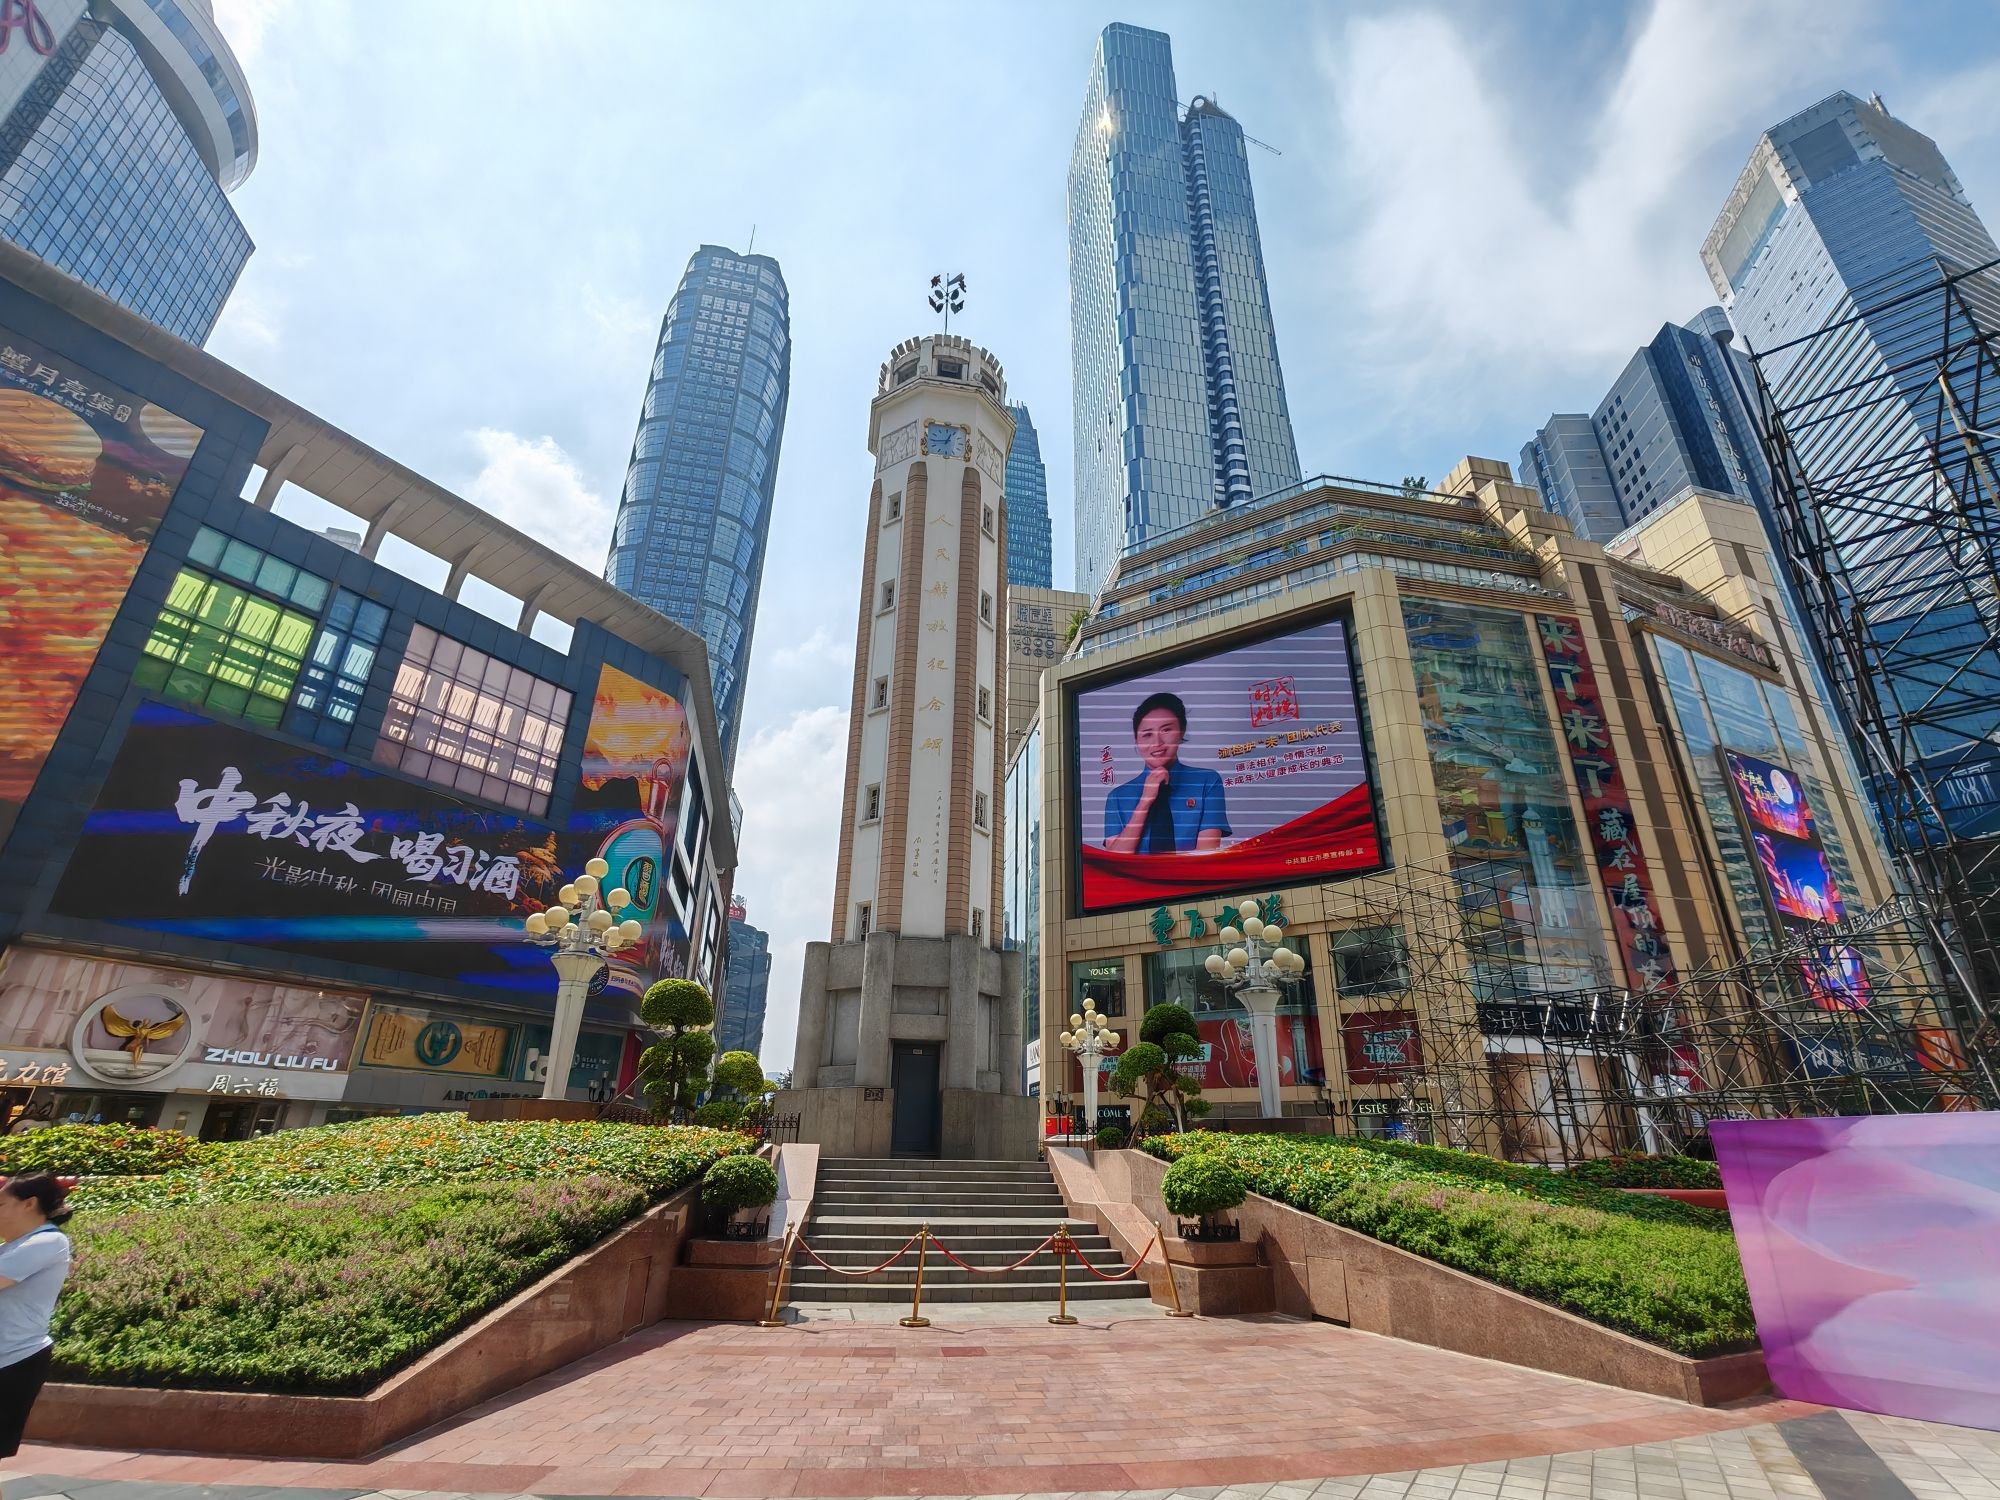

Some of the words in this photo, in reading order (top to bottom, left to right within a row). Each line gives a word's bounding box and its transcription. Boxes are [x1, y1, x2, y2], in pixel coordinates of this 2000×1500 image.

[1538, 615, 1612, 799] 来了来了
[1224, 754, 1345, 787] 未成年人健康成长的典范
[1235, 754, 1277, 772] 德法相伴
[1283, 745, 1327, 761] 倾情守护
[175, 766, 386, 896] 中秋夜
[390, 831, 521, 900] 喝习酒
[205, 1048, 271, 1066] ZHOU
[274, 1054, 306, 1068] LIU
[309, 1058, 339, 1071] FU
[206, 1074, 281, 1097] 周六福
[443, 1088, 474, 1101] ABC
[1081, 1107, 1124, 1119] LCÔME
